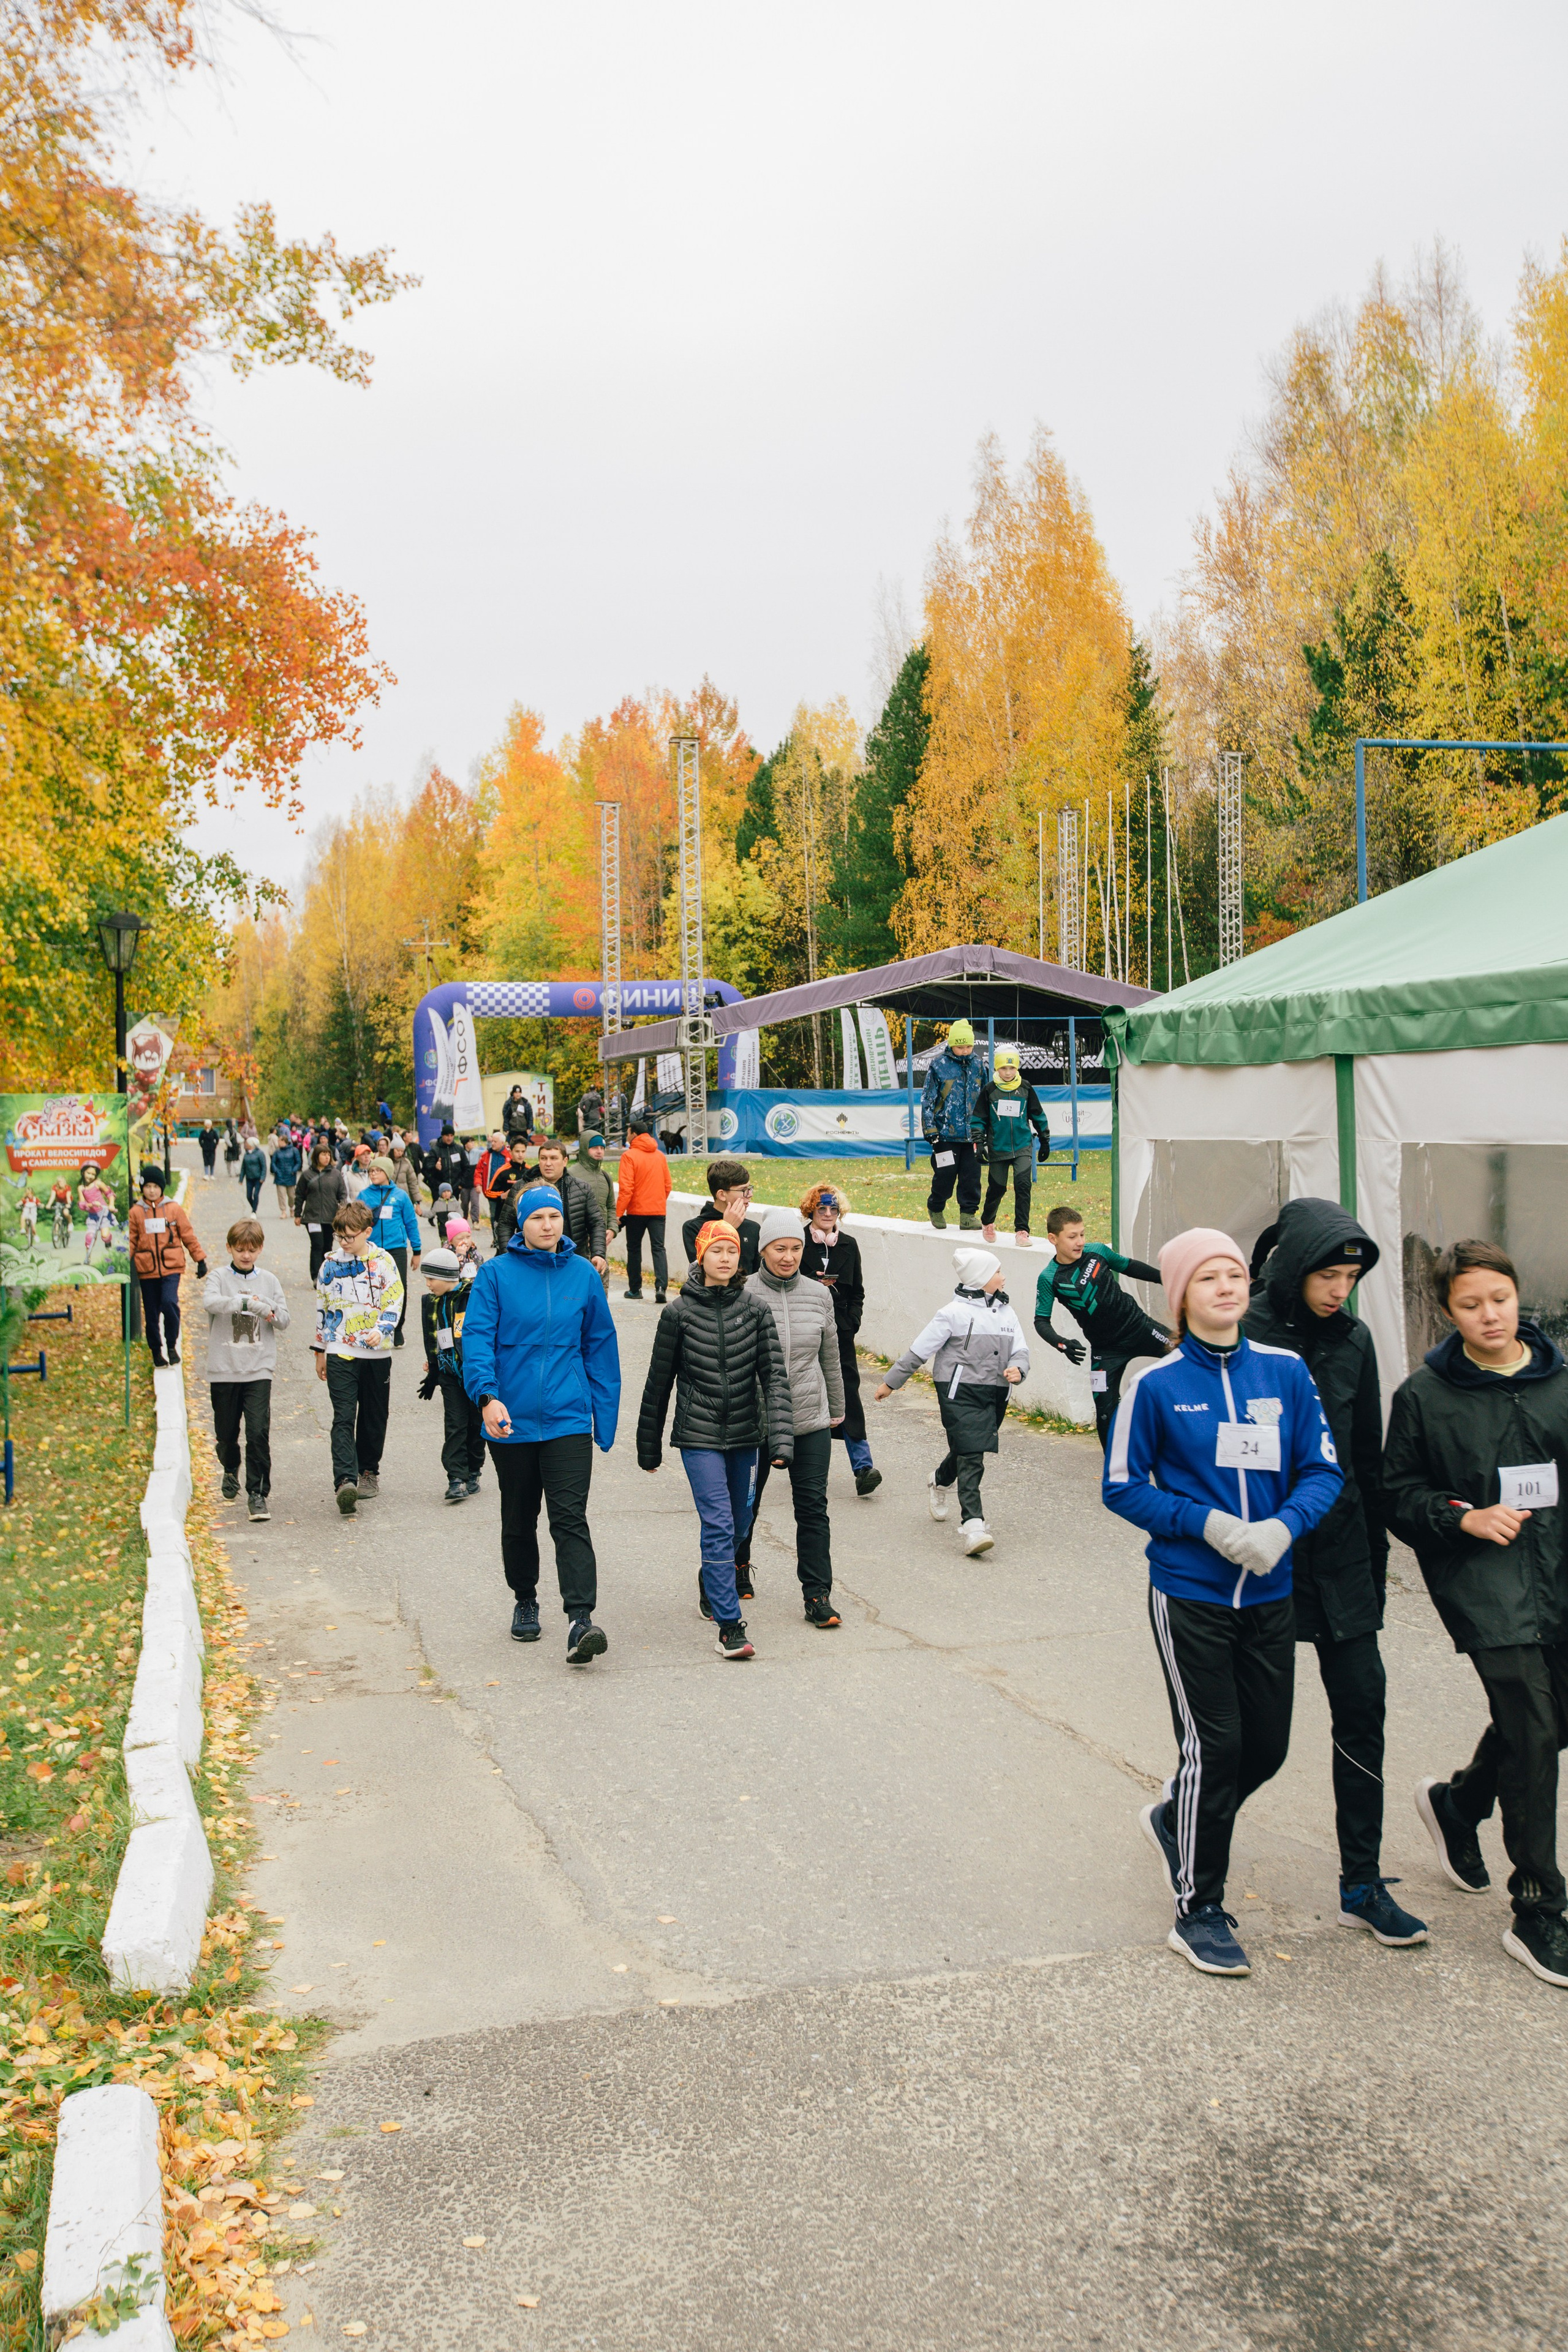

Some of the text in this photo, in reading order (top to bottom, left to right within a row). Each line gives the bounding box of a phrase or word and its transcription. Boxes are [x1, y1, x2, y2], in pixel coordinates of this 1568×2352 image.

[537, 1082, 546, 1117] ТИР
[1066, 1116, 1080, 1125] Uga
[23, 1123, 94, 1140] СКАЗКА
[14, 1148, 107, 1158] ПРОКАТ ВЕЛОСИПЕДОВ
[29, 1159, 80, 1167] САМОКАТОВ
[1080, 1258, 1097, 1285] O-UGRA
[1174, 1403, 1210, 1412] KELME
[1240, 1441, 1260, 1455] 24
[1517, 1481, 1542, 1496] 101
